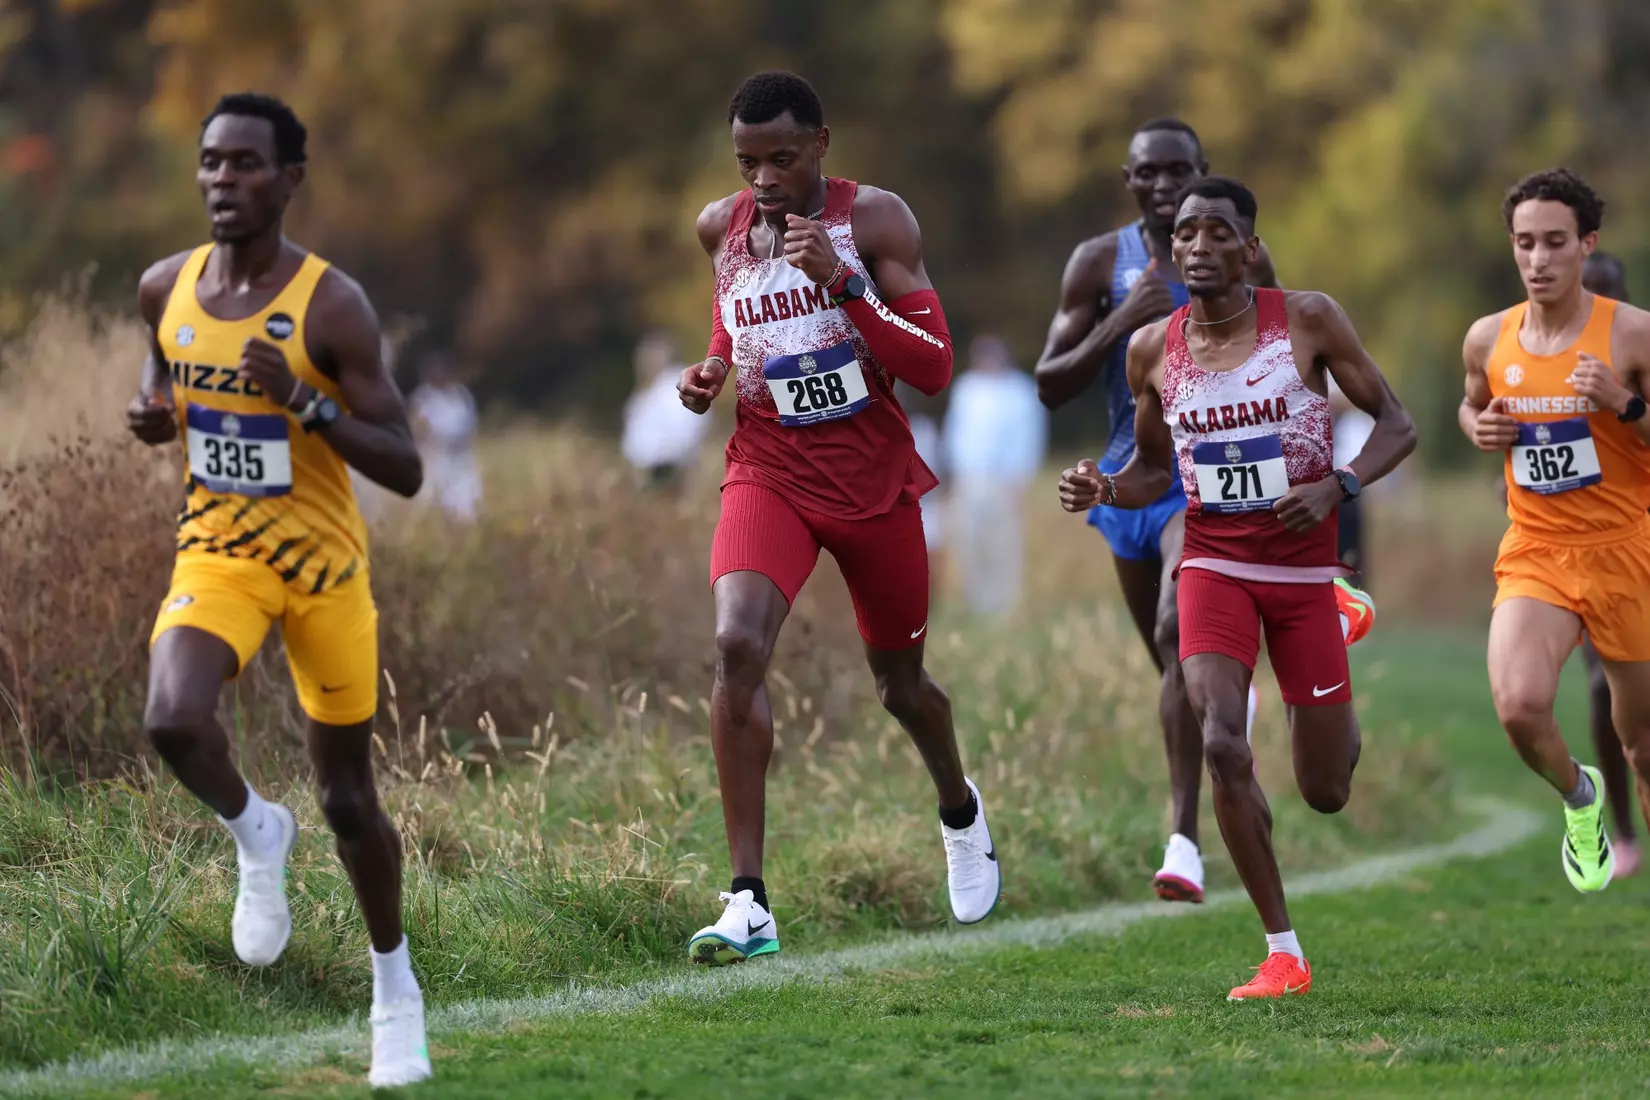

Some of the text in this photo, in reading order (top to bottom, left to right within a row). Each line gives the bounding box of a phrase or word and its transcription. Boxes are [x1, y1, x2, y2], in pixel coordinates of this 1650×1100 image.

[787, 372, 848, 413] 268
[1178, 382, 1193, 400] SEC
[1179, 396, 1290, 434] ALABAMA
[204, 438, 264, 481] 335
[1525, 445, 1579, 482] 362
[1217, 464, 1264, 500] 271
